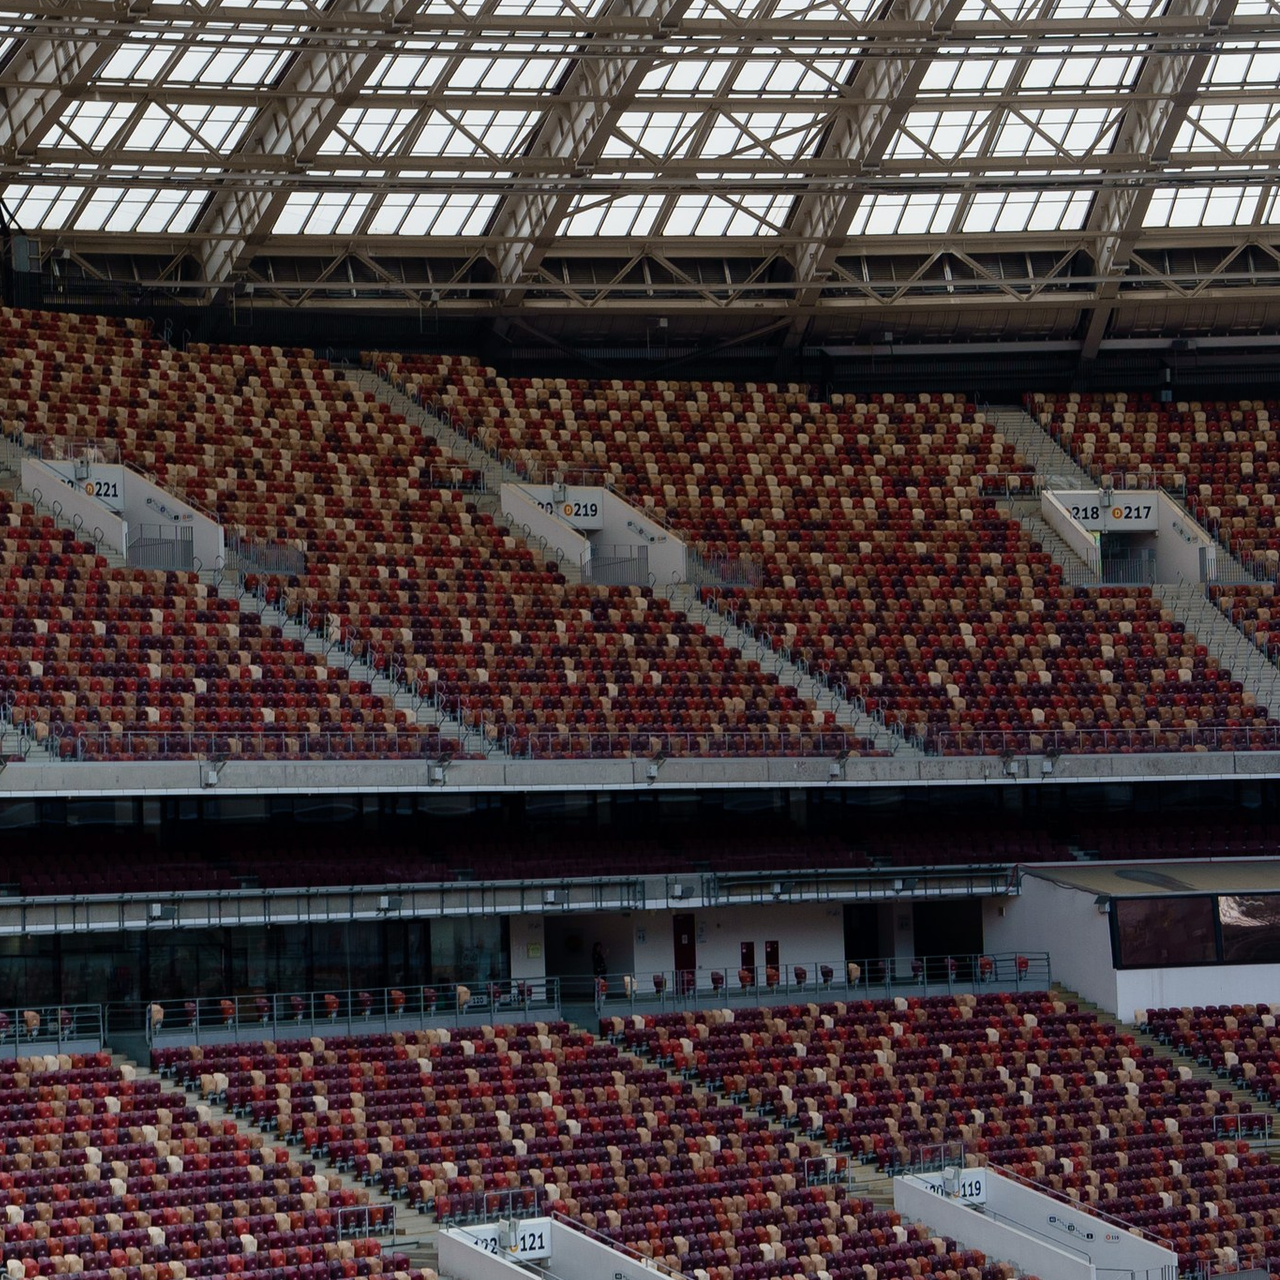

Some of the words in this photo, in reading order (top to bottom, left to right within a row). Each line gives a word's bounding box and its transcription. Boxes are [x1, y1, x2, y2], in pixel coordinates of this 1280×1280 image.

[95, 481, 119, 497] 221
[573, 502, 598, 517] 219
[1072, 506, 1099, 520] 218
[1124, 505, 1152, 519] 217
[961, 1180, 982, 1197] 119
[520, 1232, 545, 1252] 121
